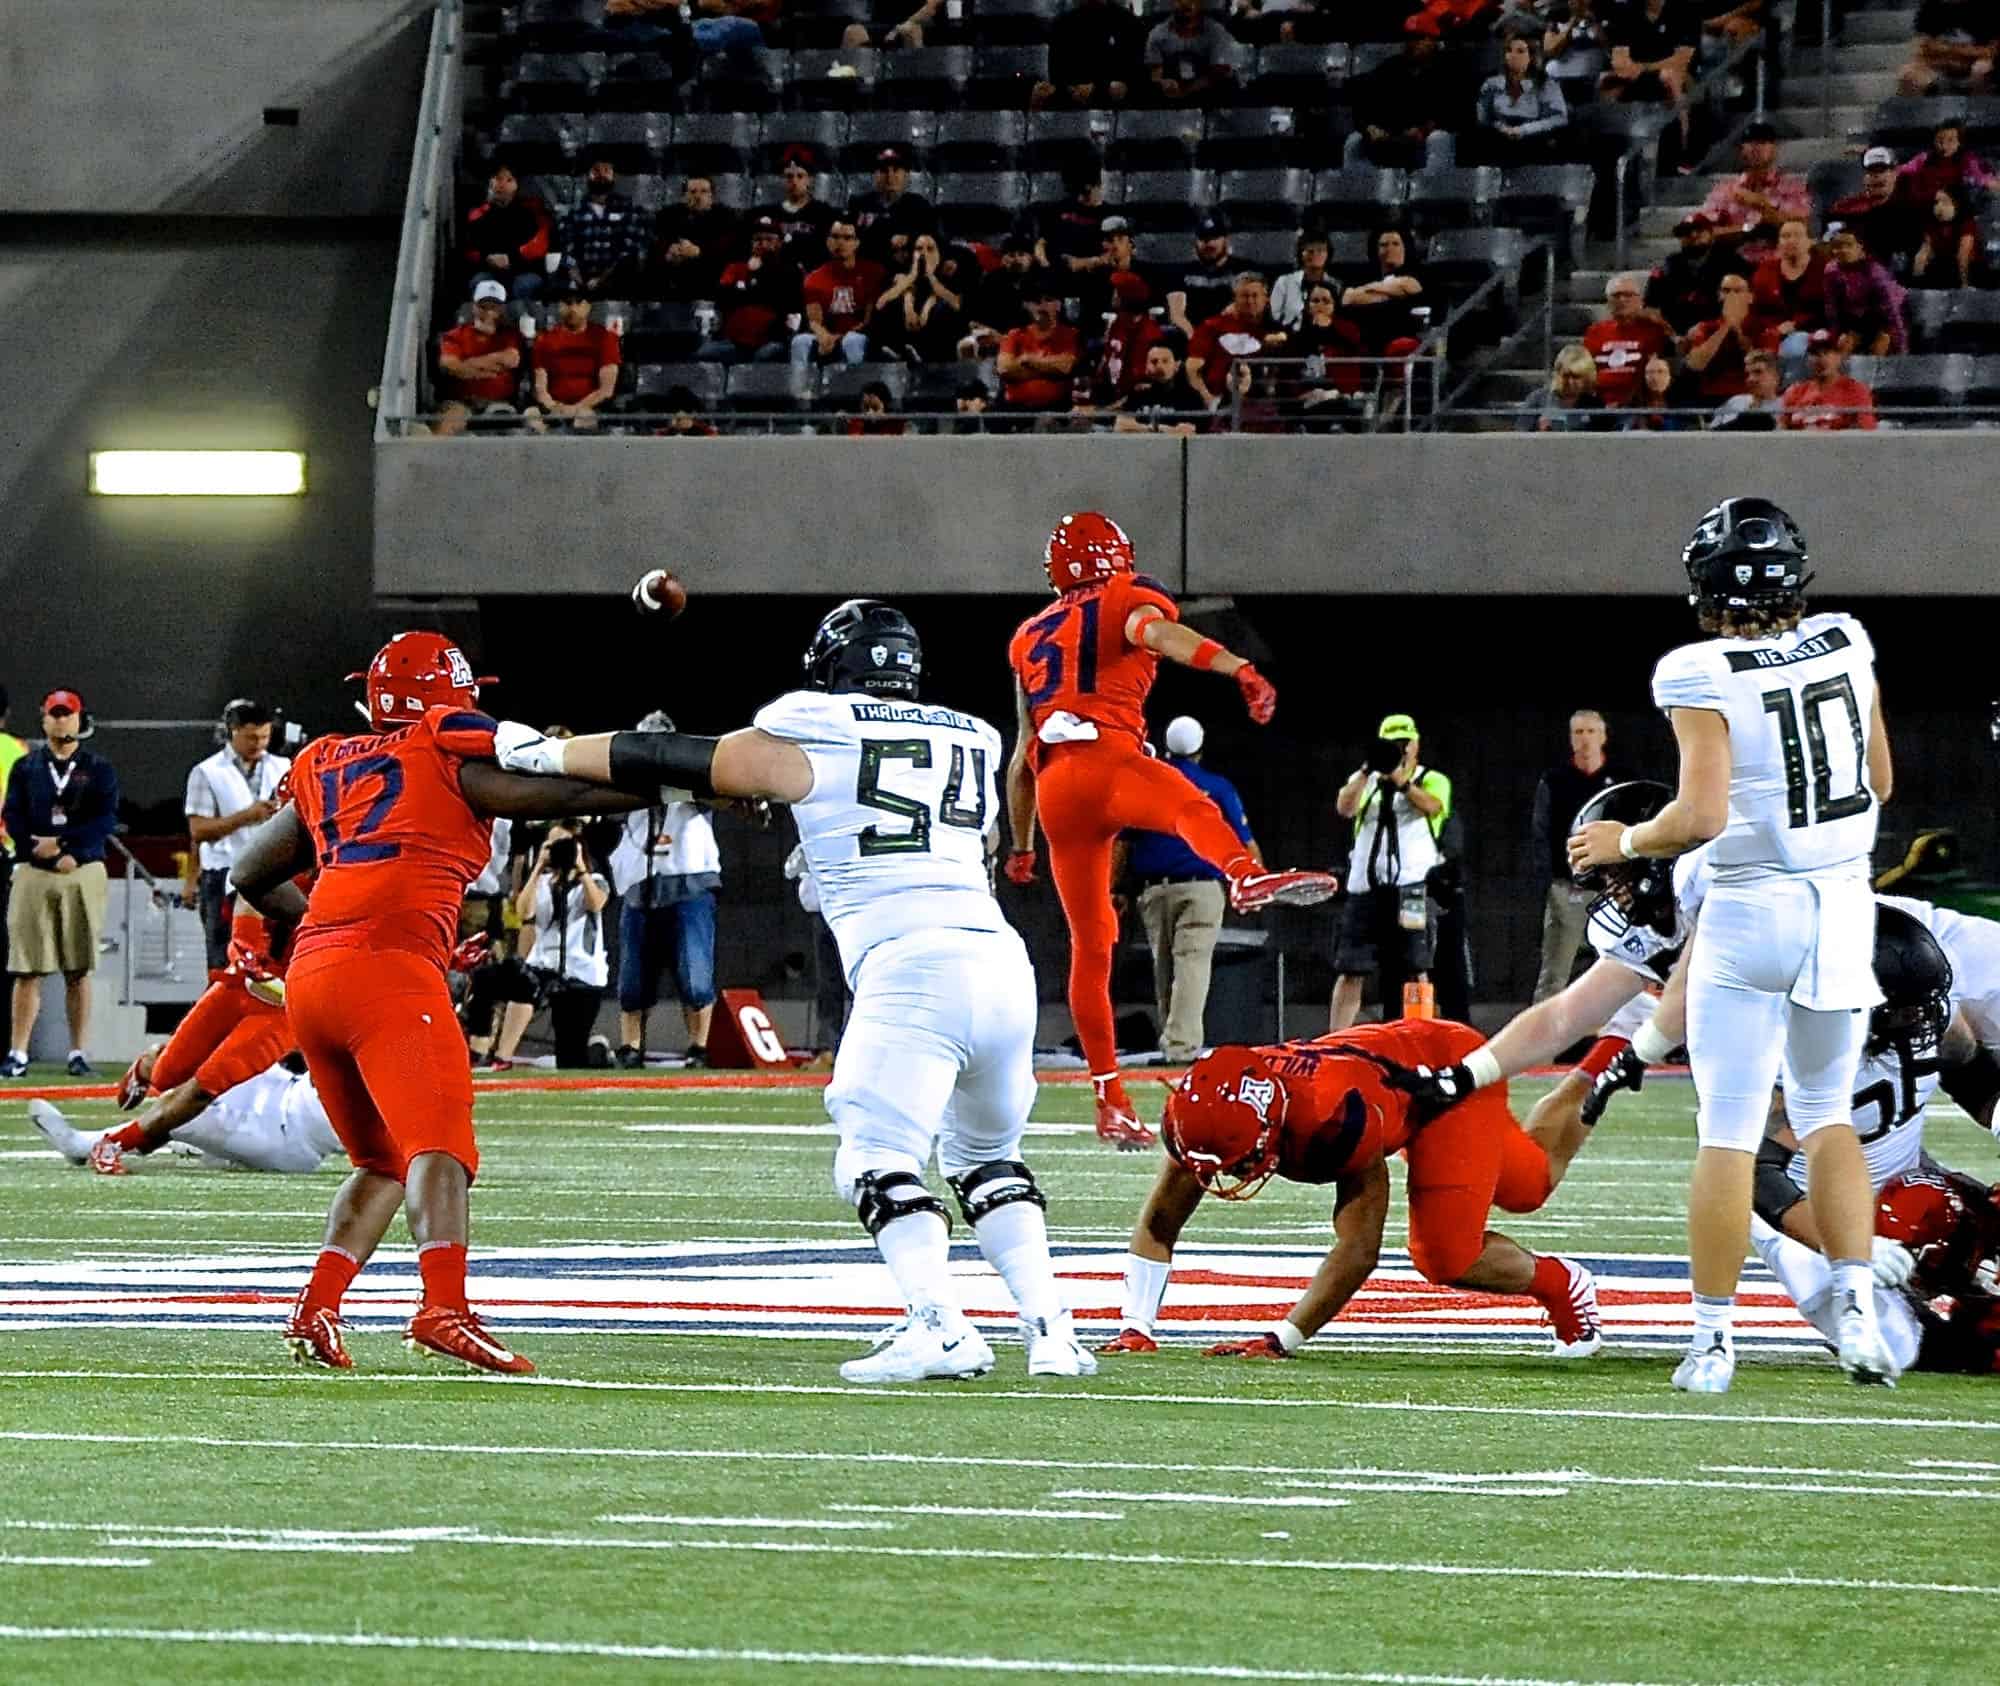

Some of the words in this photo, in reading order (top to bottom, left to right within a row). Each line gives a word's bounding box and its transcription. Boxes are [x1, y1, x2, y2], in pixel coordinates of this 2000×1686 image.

[1027, 600, 1099, 711] 31
[856, 739, 987, 857] 54
[1761, 673, 1872, 829] 10
[318, 753, 404, 865] 12
[739, 1006, 787, 1062] G
